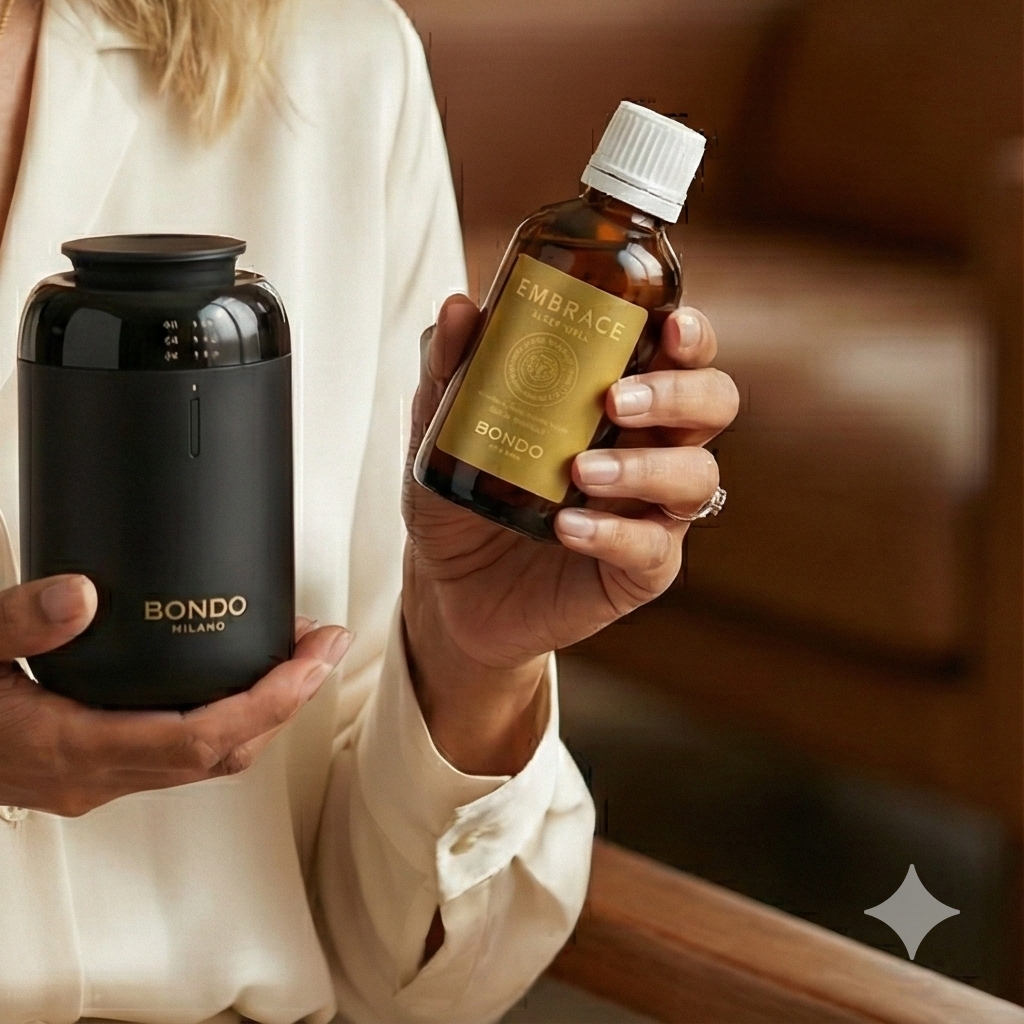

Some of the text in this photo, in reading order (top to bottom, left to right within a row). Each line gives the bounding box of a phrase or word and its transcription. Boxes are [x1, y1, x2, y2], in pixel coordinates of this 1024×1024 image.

[516, 277, 626, 342] EMBRACE
[474, 420, 544, 459] BONDO
[144, 595, 247, 620] BONDO
[171, 621, 226, 634] MILANO
